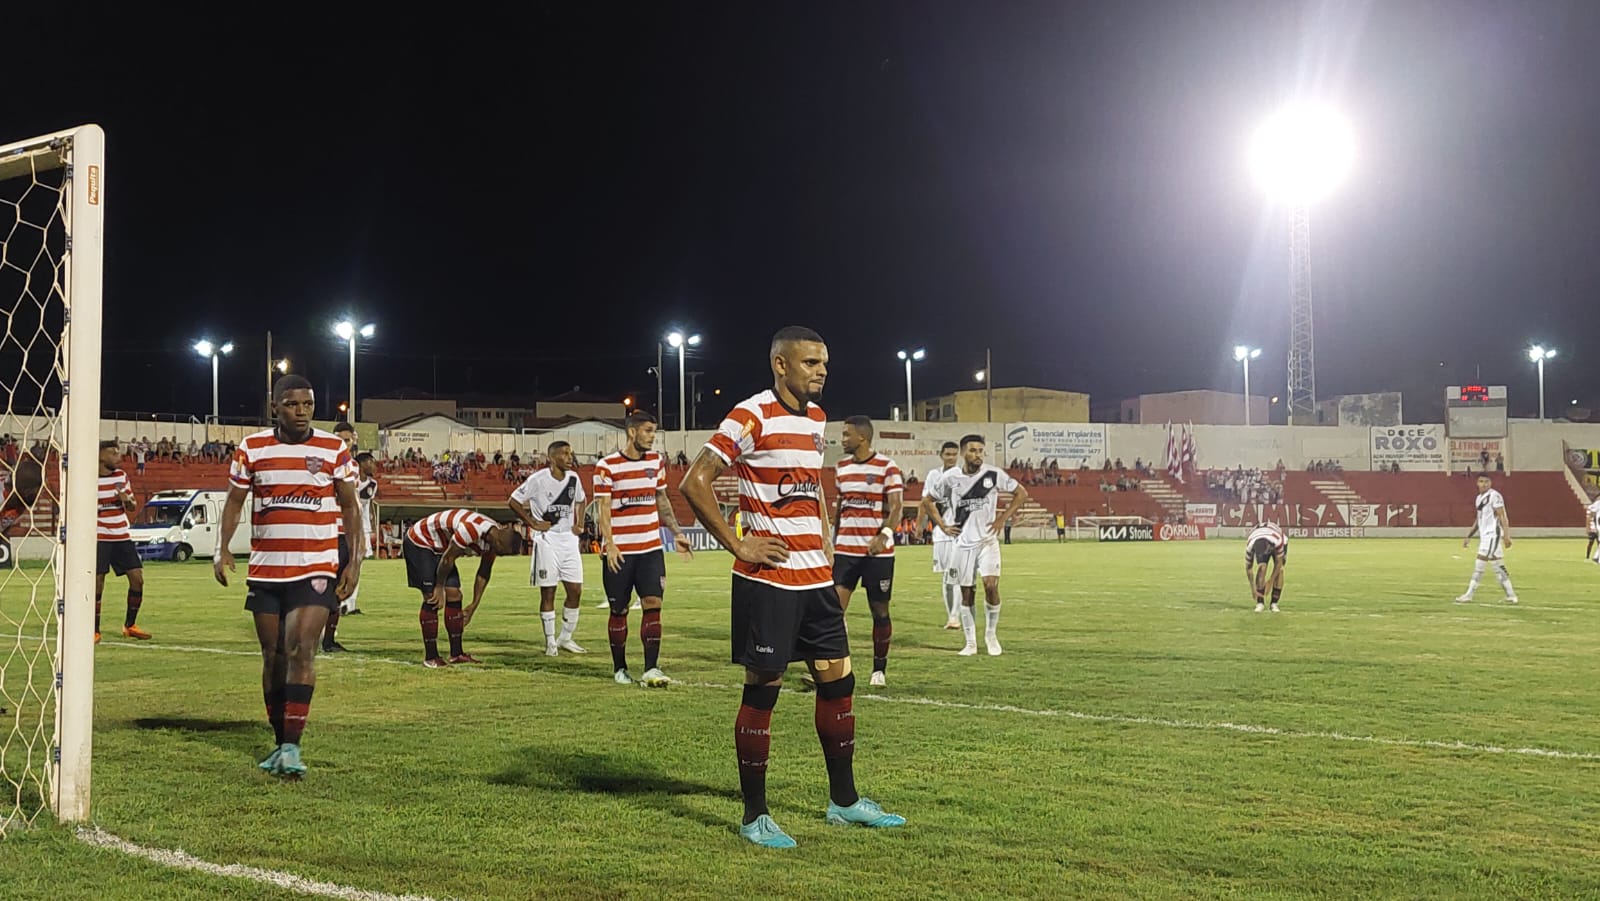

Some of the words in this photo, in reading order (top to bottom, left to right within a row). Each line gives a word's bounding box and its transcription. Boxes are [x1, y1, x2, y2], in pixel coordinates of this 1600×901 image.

[1033, 429, 1064, 437] Essencial
[1375, 437, 1437, 450] ROXO
[1223, 504, 1348, 526] CAMISA
[1374, 504, 1416, 526] 12
[1100, 526, 1127, 540] KIA
[1129, 526, 1152, 540] Stonic
[1173, 524, 1200, 537] KRONA
[1289, 528, 1308, 537] PELO
[1313, 528, 1350, 537] LINENSE
